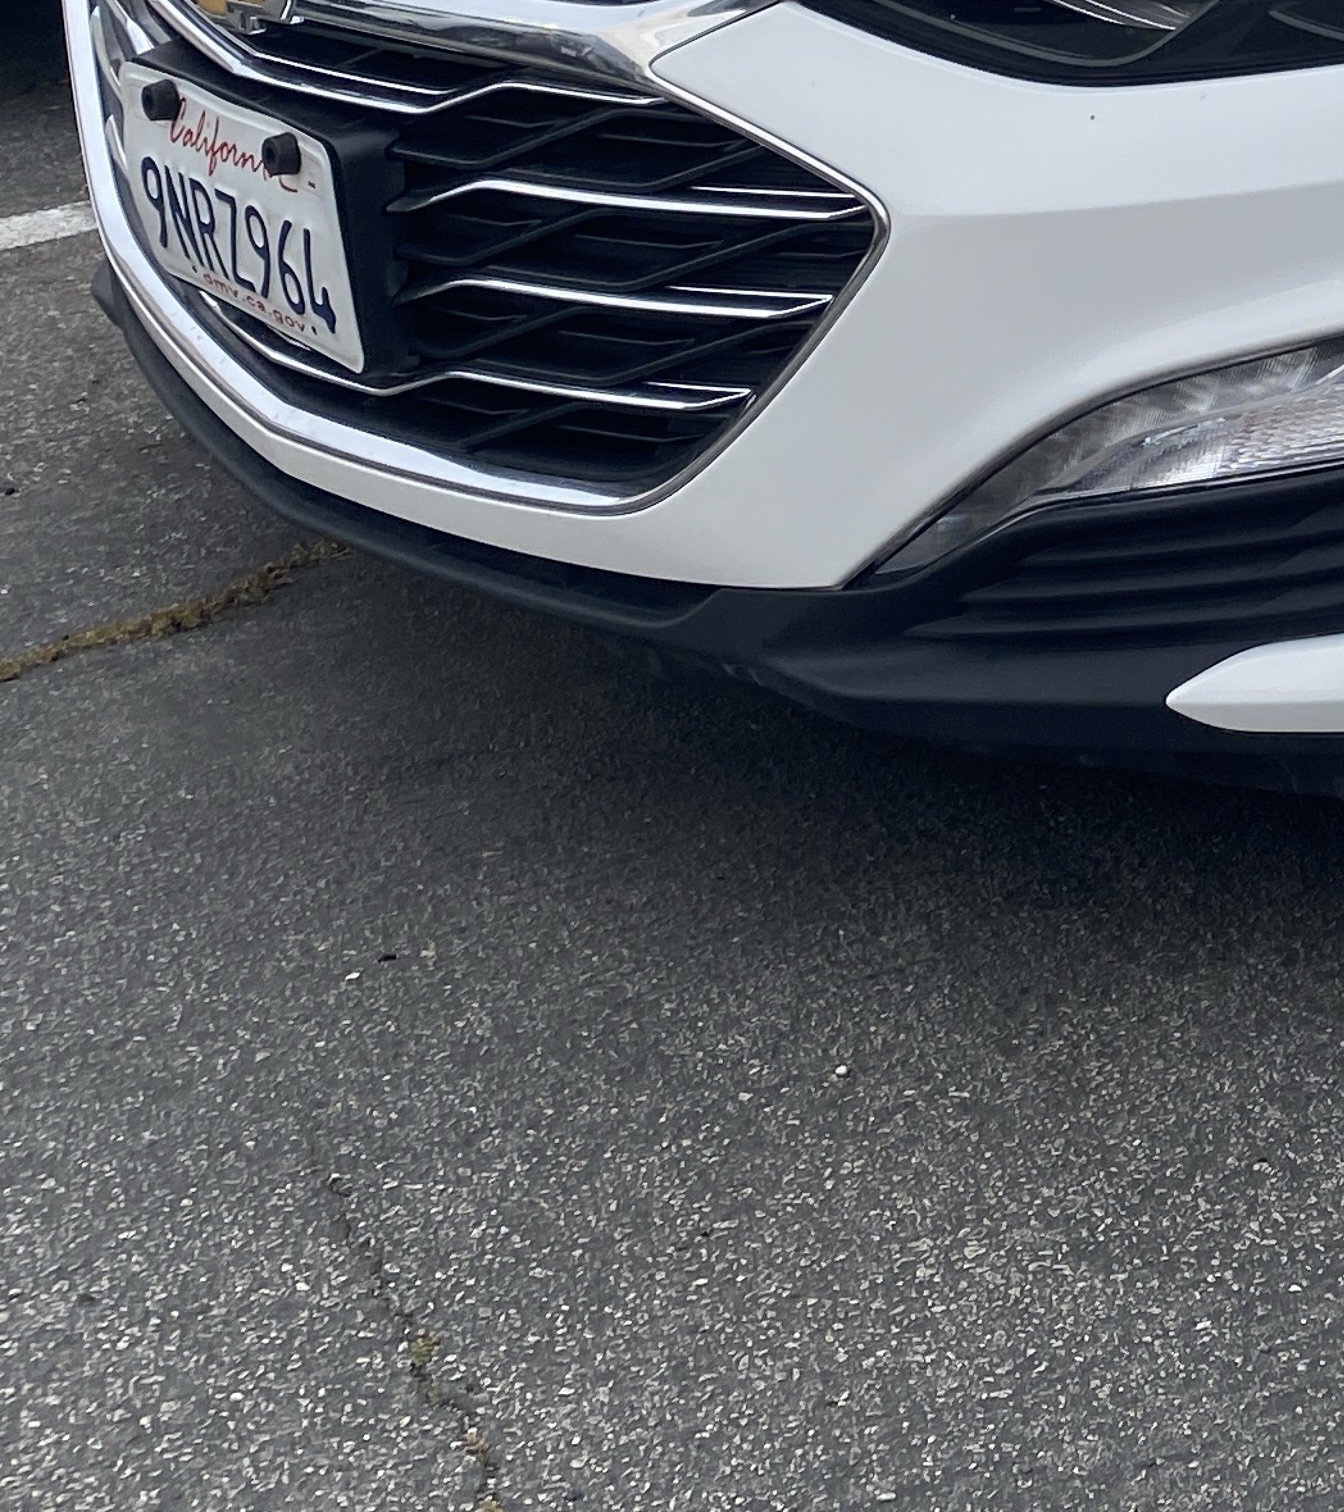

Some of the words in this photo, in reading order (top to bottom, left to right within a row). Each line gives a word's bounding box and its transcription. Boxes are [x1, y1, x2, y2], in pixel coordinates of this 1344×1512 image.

[169, 96, 298, 193] Californ
[141, 156, 336, 334] 9NRZ964
[203, 273, 306, 333] dmv.ca.gov
